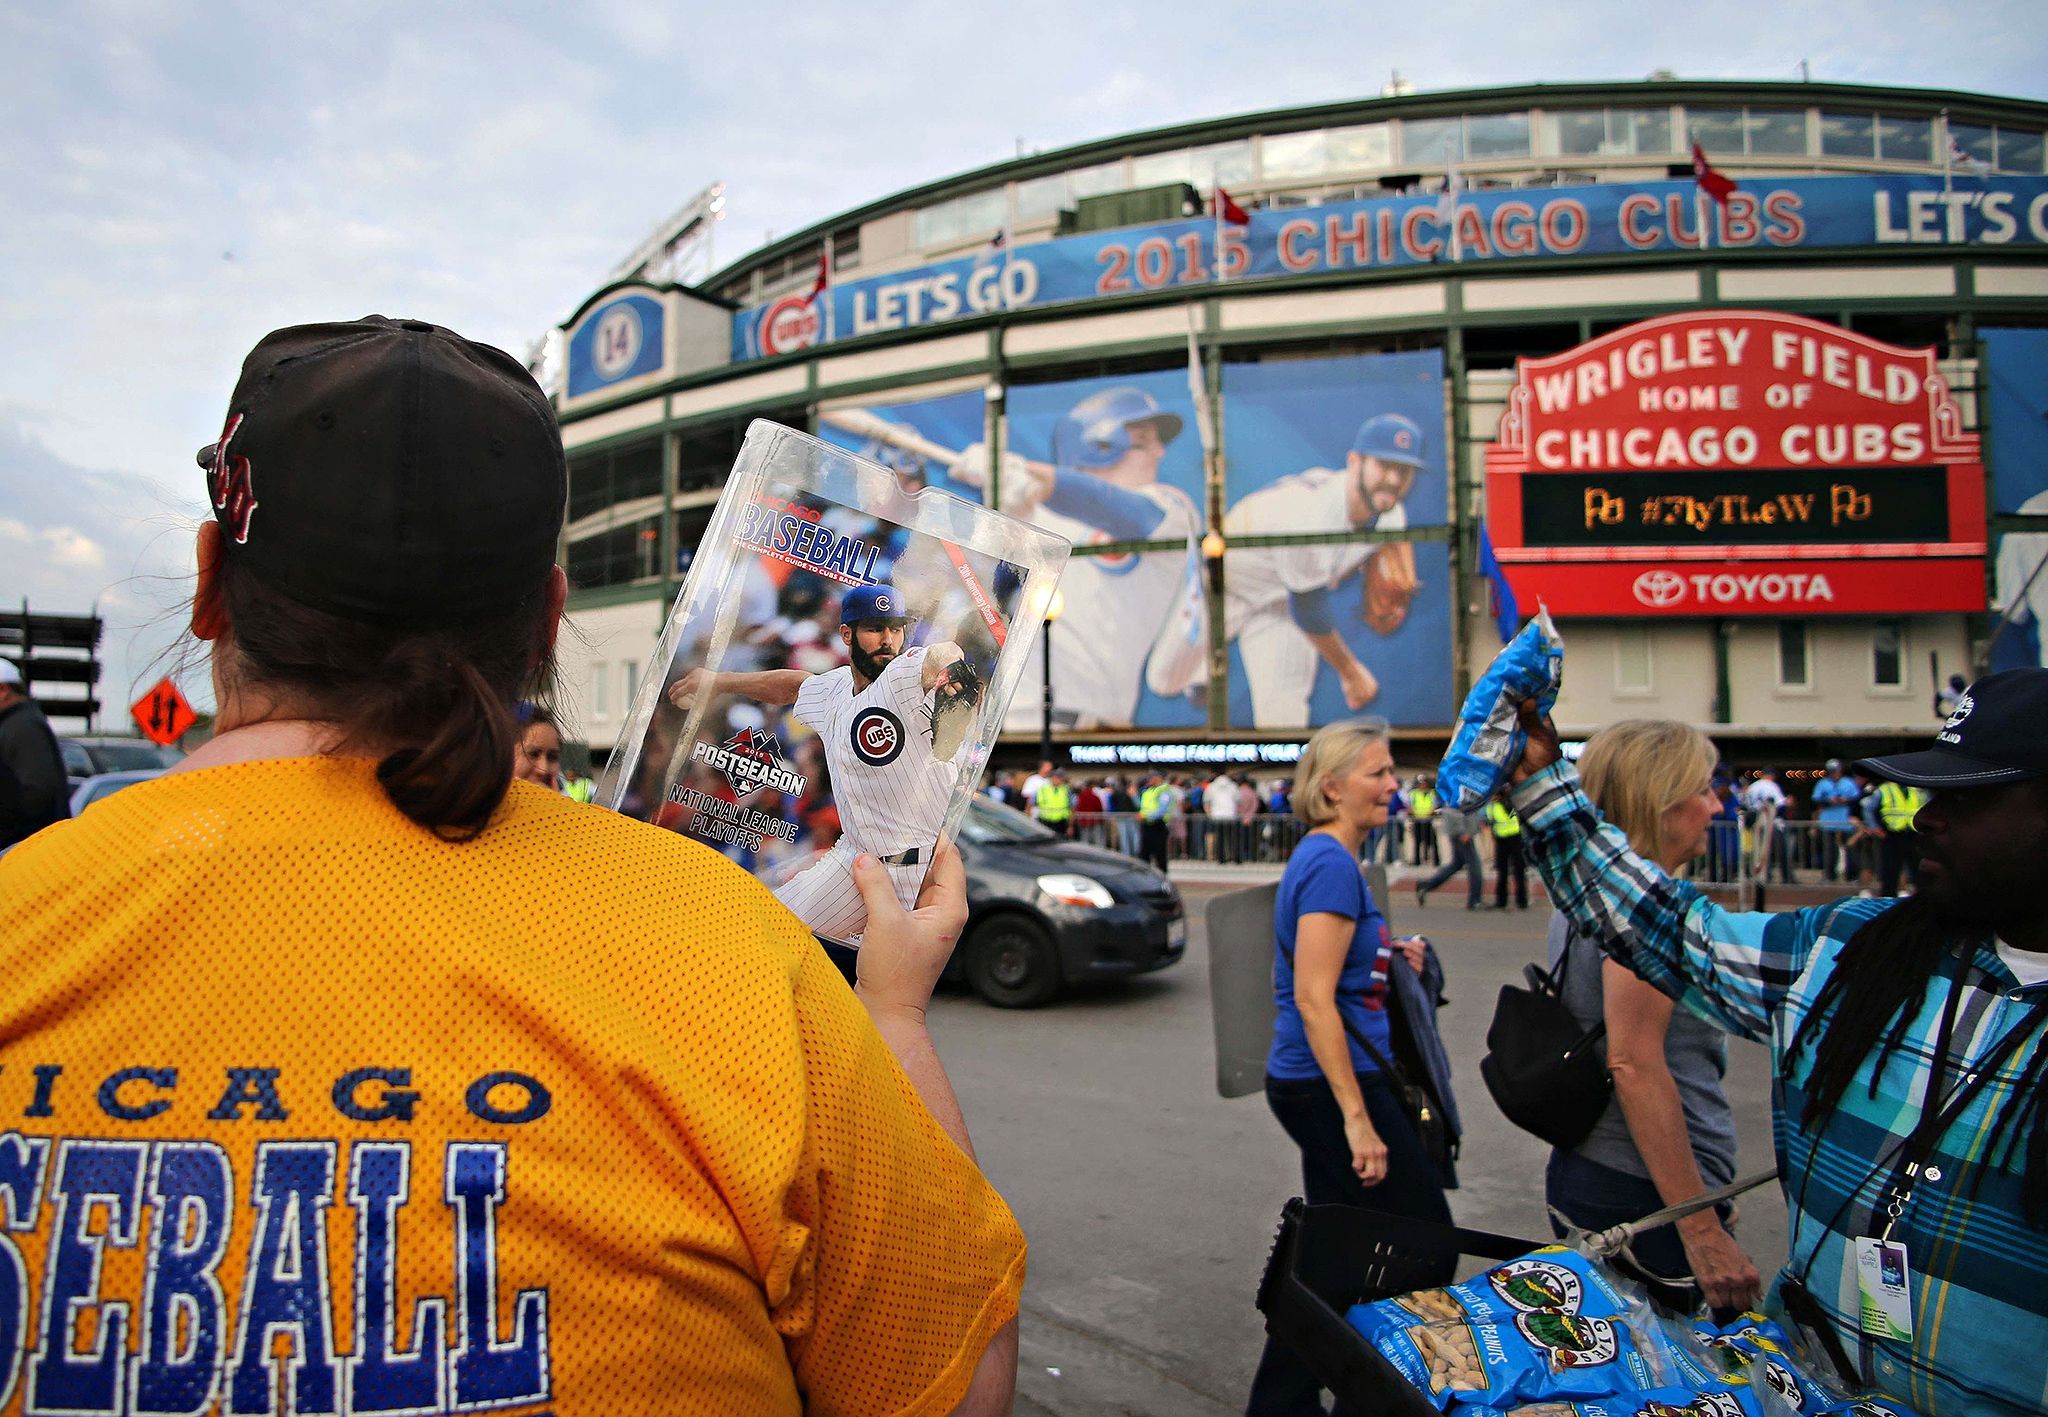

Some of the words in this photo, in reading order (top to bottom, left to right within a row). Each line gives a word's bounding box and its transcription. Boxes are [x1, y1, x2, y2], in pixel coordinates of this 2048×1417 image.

[1873, 190, 2017, 244] LET'S
[1096, 226, 1252, 295] 2015
[1278, 198, 1588, 273] CHICAGO
[1618, 191, 1806, 250] CUBS
[853, 273, 958, 335] LET'S
[967, 259, 1039, 312] GO
[604, 323, 628, 364] 14
[1534, 327, 1749, 415] WRIGLEY
[1772, 330, 1920, 405] FIELD
[1639, 385, 1740, 412] HOME
[1765, 383, 1812, 409] OF
[1535, 425, 1759, 469] CHICAGO
[1781, 423, 1924, 465] CUBS
[733, 501, 881, 586] BASEBALL
[751, 544, 784, 562] COMPLETE
[784, 556, 807, 570] GUIDE
[808, 564, 819, 573] TO
[819, 568, 838, 580] CUBS
[1689, 573, 1834, 601] TOYOTA
[980, 604, 997, 626] Season
[859, 717, 895, 755] CUBS
[690, 740, 808, 798] POSTSEASON
[668, 783, 740, 825] NATIONAL
[739, 807, 799, 844] LEAGUE
[689, 813, 764, 853] PLAYOFFS
[0, 1064, 551, 1123] ICAGO
[1516, 1261, 1578, 1317] ARGIRES
[1479, 1323, 1508, 1365] PEANUTS
